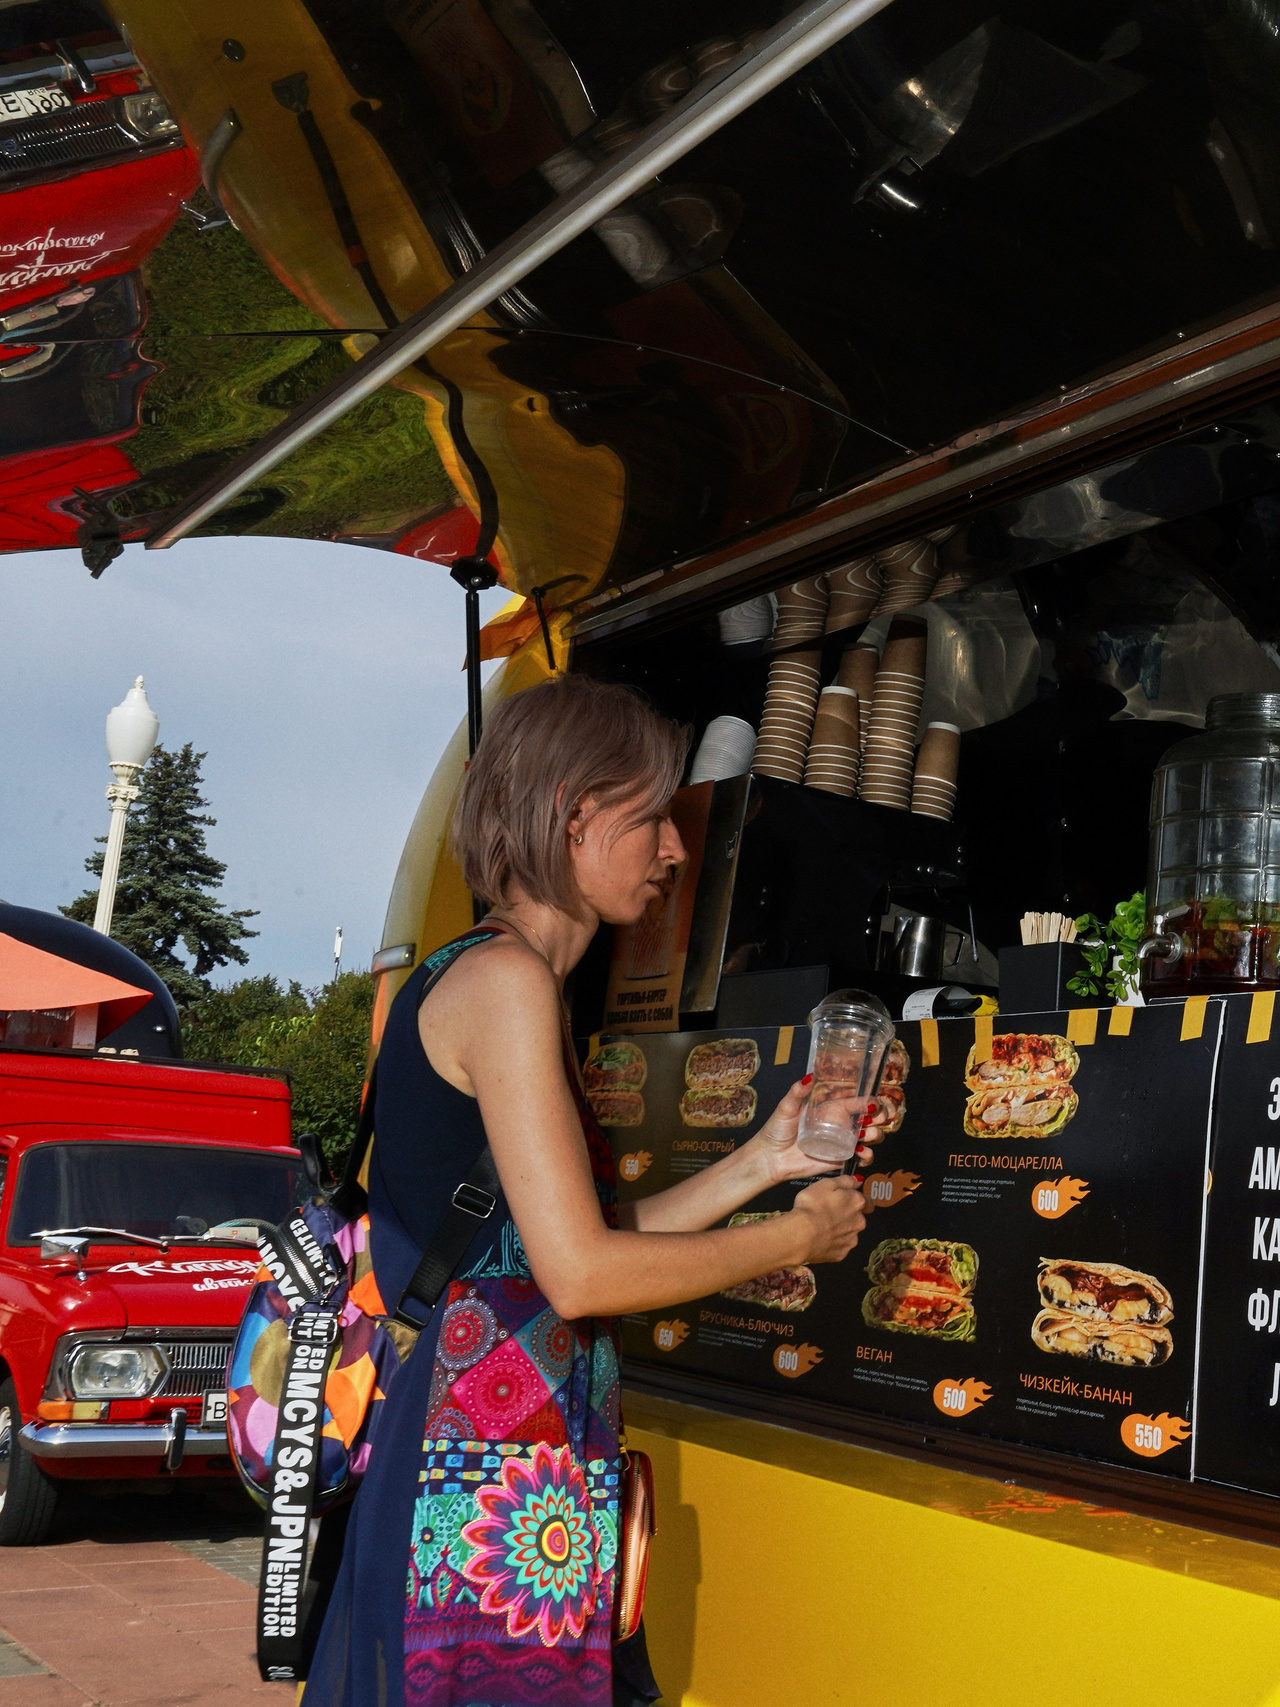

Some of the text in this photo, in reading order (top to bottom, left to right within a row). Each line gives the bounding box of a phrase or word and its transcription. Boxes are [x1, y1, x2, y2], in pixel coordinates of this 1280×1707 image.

[672, 1139, 735, 1153] СЫРНО-ОСТРЫЙ
[948, 1154, 1063, 1172] ПЕСТО-МОЦАРЕЛЛА
[870, 1180, 893, 1201] 600
[1037, 1188, 1059, 1212] 600
[778, 1350, 798, 1372] 600
[856, 1345, 893, 1363] ВЕГАН
[943, 1386, 967, 1411] 500
[1019, 1373, 1133, 1406] ЧИЗКЕЙК-БАНАН
[1134, 1422, 1162, 1451] 550
[267, 1372, 322, 1562] MCYS&JPN
[263, 1561, 285, 1637] EDITION
[280, 1562, 301, 1638] LIMITED
